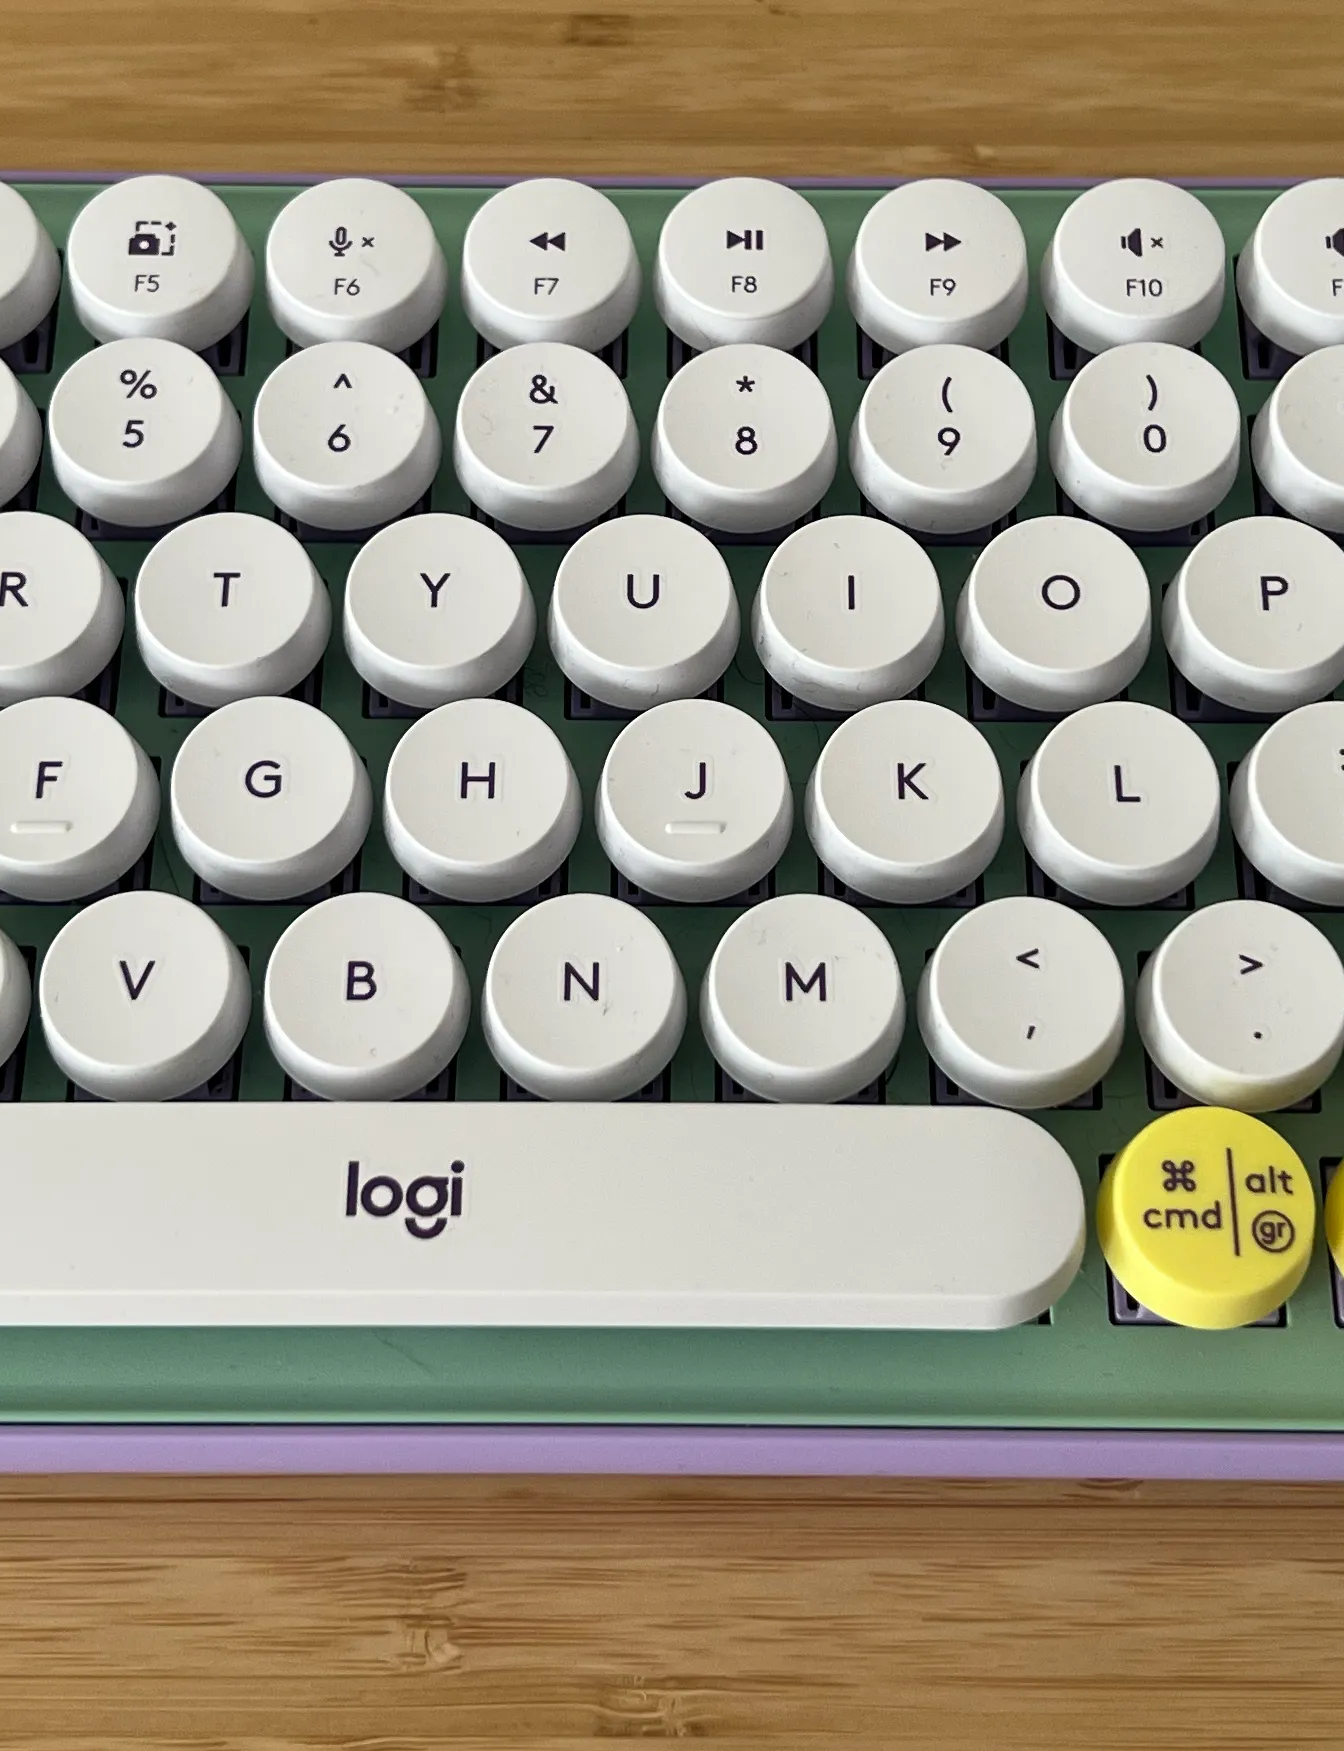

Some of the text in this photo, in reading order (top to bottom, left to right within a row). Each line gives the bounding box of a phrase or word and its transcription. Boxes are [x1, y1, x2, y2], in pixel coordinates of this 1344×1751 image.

[134, 274, 160, 293] F5
[333, 277, 361, 297] F6
[534, 277, 560, 296] F7
[731, 275, 758, 294] F8
[930, 278, 957, 297] F9
[1126, 278, 1163, 297] F10
[122, 419, 145, 449] 5
[327, 423, 352, 453] 6
[532, 425, 555, 454] 7
[734, 426, 758, 456] 8
[937, 426, 961, 456] 9
[1143, 424, 1167, 454] 0
[213, 572, 241, 608] T
[419, 572, 451, 608] Y
[626, 573, 660, 610] U
[847, 574, 856, 611] I
[1041, 574, 1081, 611] O
[1260, 575, 1289, 612] P
[35, 760, 64, 800] F
[244, 759, 283, 799] G
[460, 761, 496, 800] H
[684, 761, 707, 800] J
[897, 762, 929, 801] K
[1113, 764, 1142, 803] L
[119, 960, 156, 1001] V
[346, 960, 378, 1001] B
[563, 961, 600, 1002] N
[784, 961, 827, 1002] M
[1244, 1165, 1294, 1196] alt
[345, 1159, 465, 1240] logi
[1143, 1199, 1223, 1230] cmd
[1258, 1217, 1289, 1245] gr
